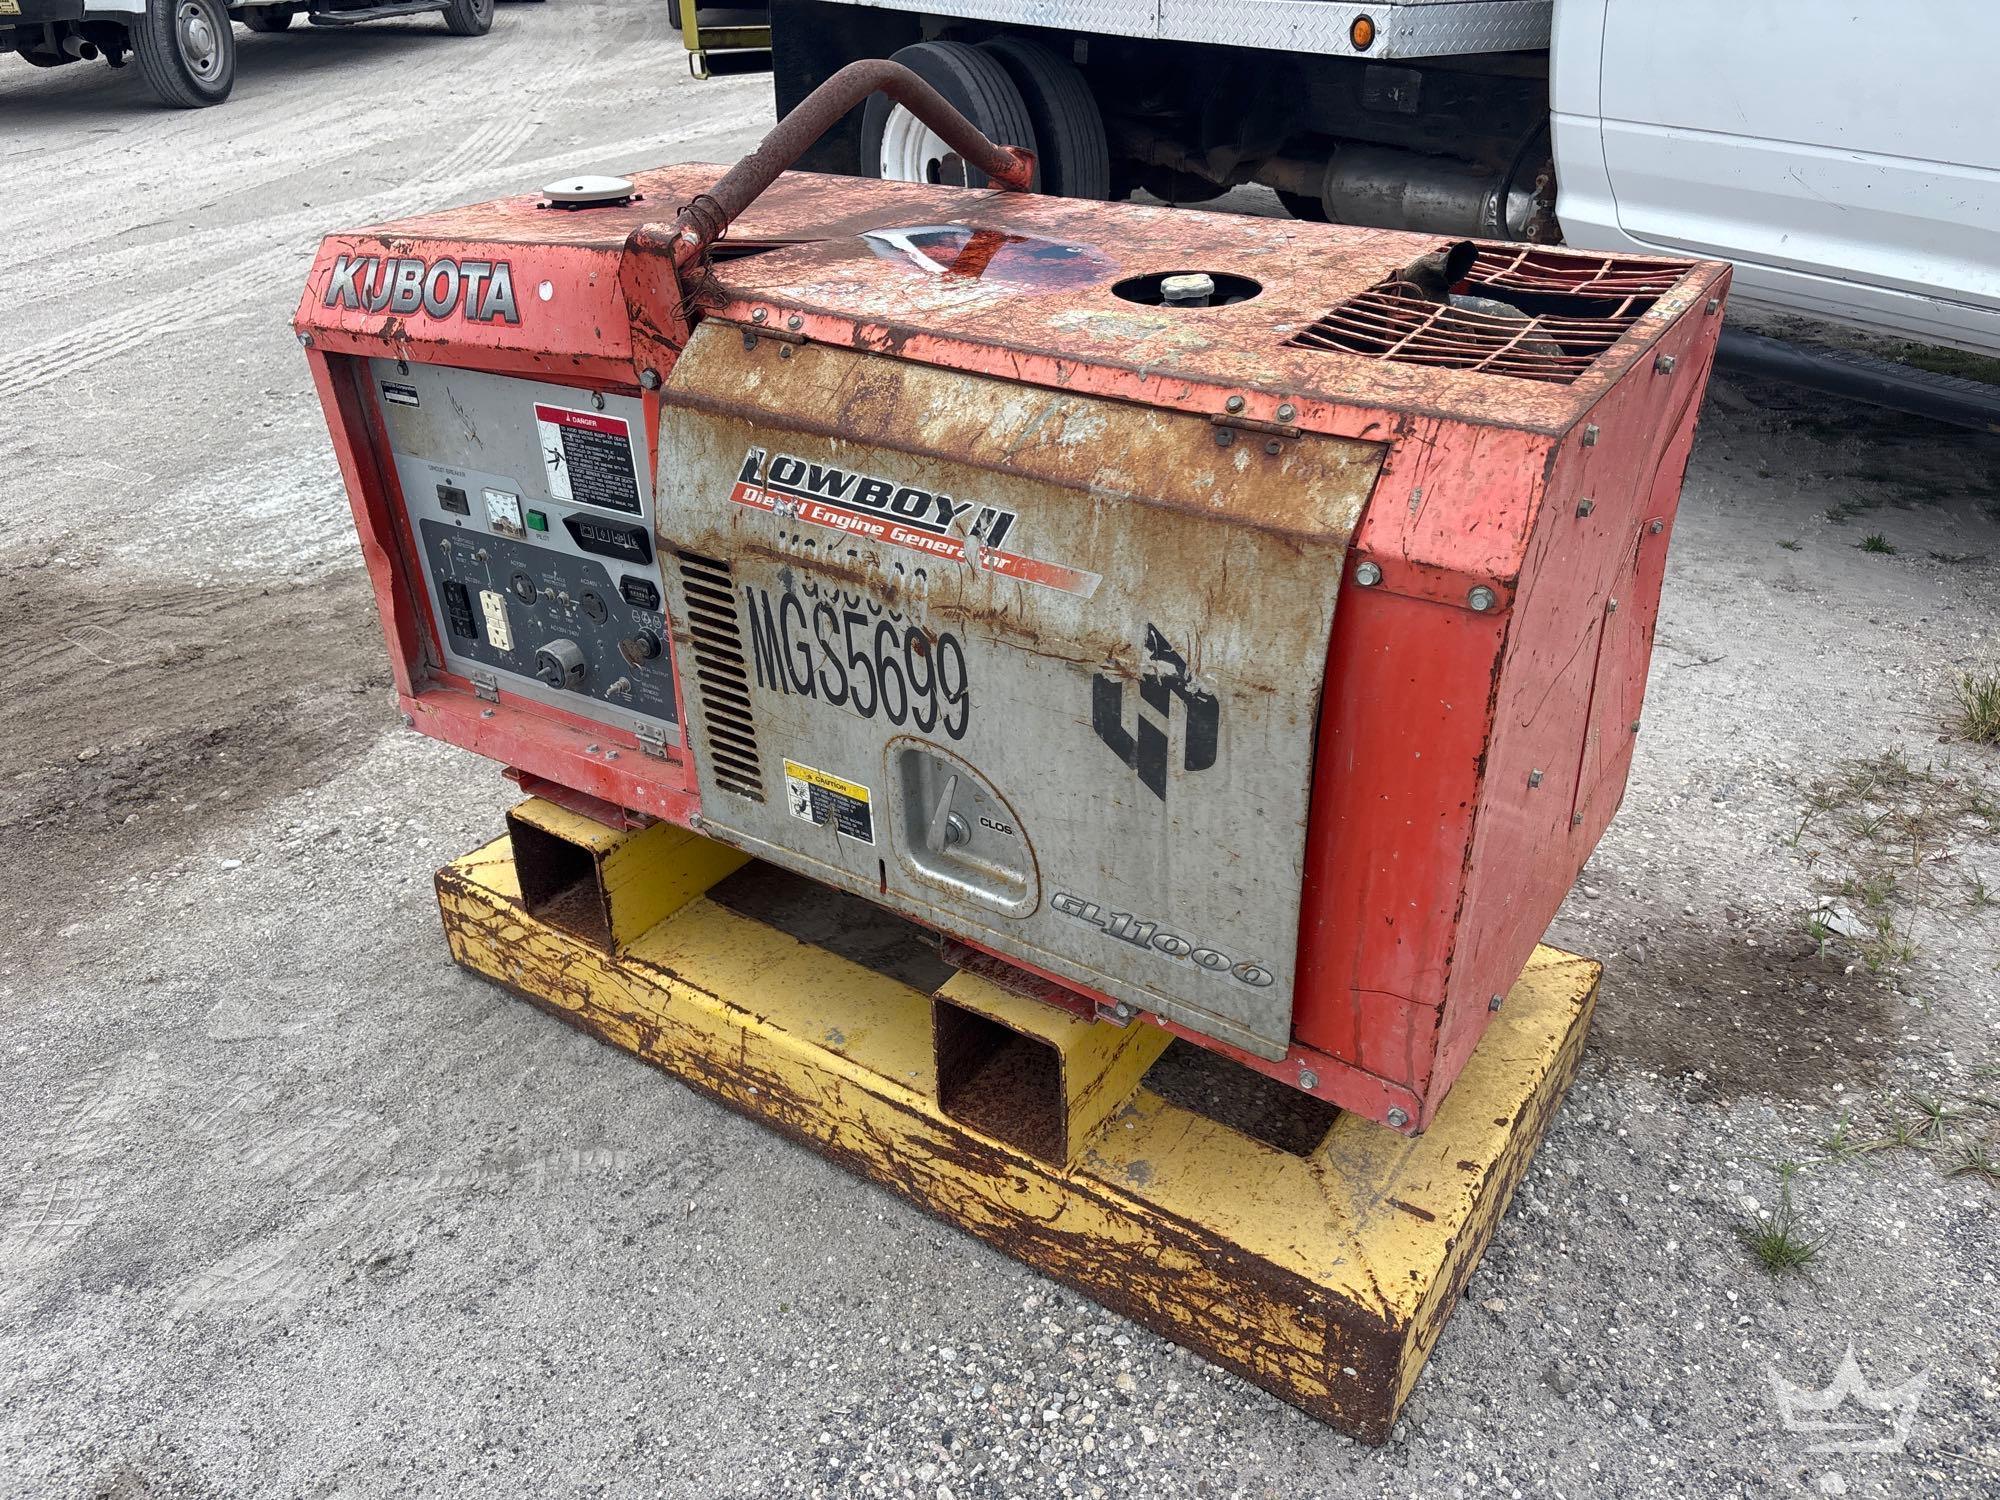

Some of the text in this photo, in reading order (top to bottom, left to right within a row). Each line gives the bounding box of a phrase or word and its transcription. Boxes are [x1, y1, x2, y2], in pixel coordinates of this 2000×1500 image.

[323, 255, 521, 325] KUBOTA
[572, 416, 597, 427] DANGER
[738, 448, 972, 527] LOWBOY
[810, 505, 885, 536] Engine
[746, 586, 970, 741] MGS5699
[815, 776, 847, 792] CAUTION
[980, 817, 1014, 835] CLOS
[1050, 892, 1274, 987] GL11000
